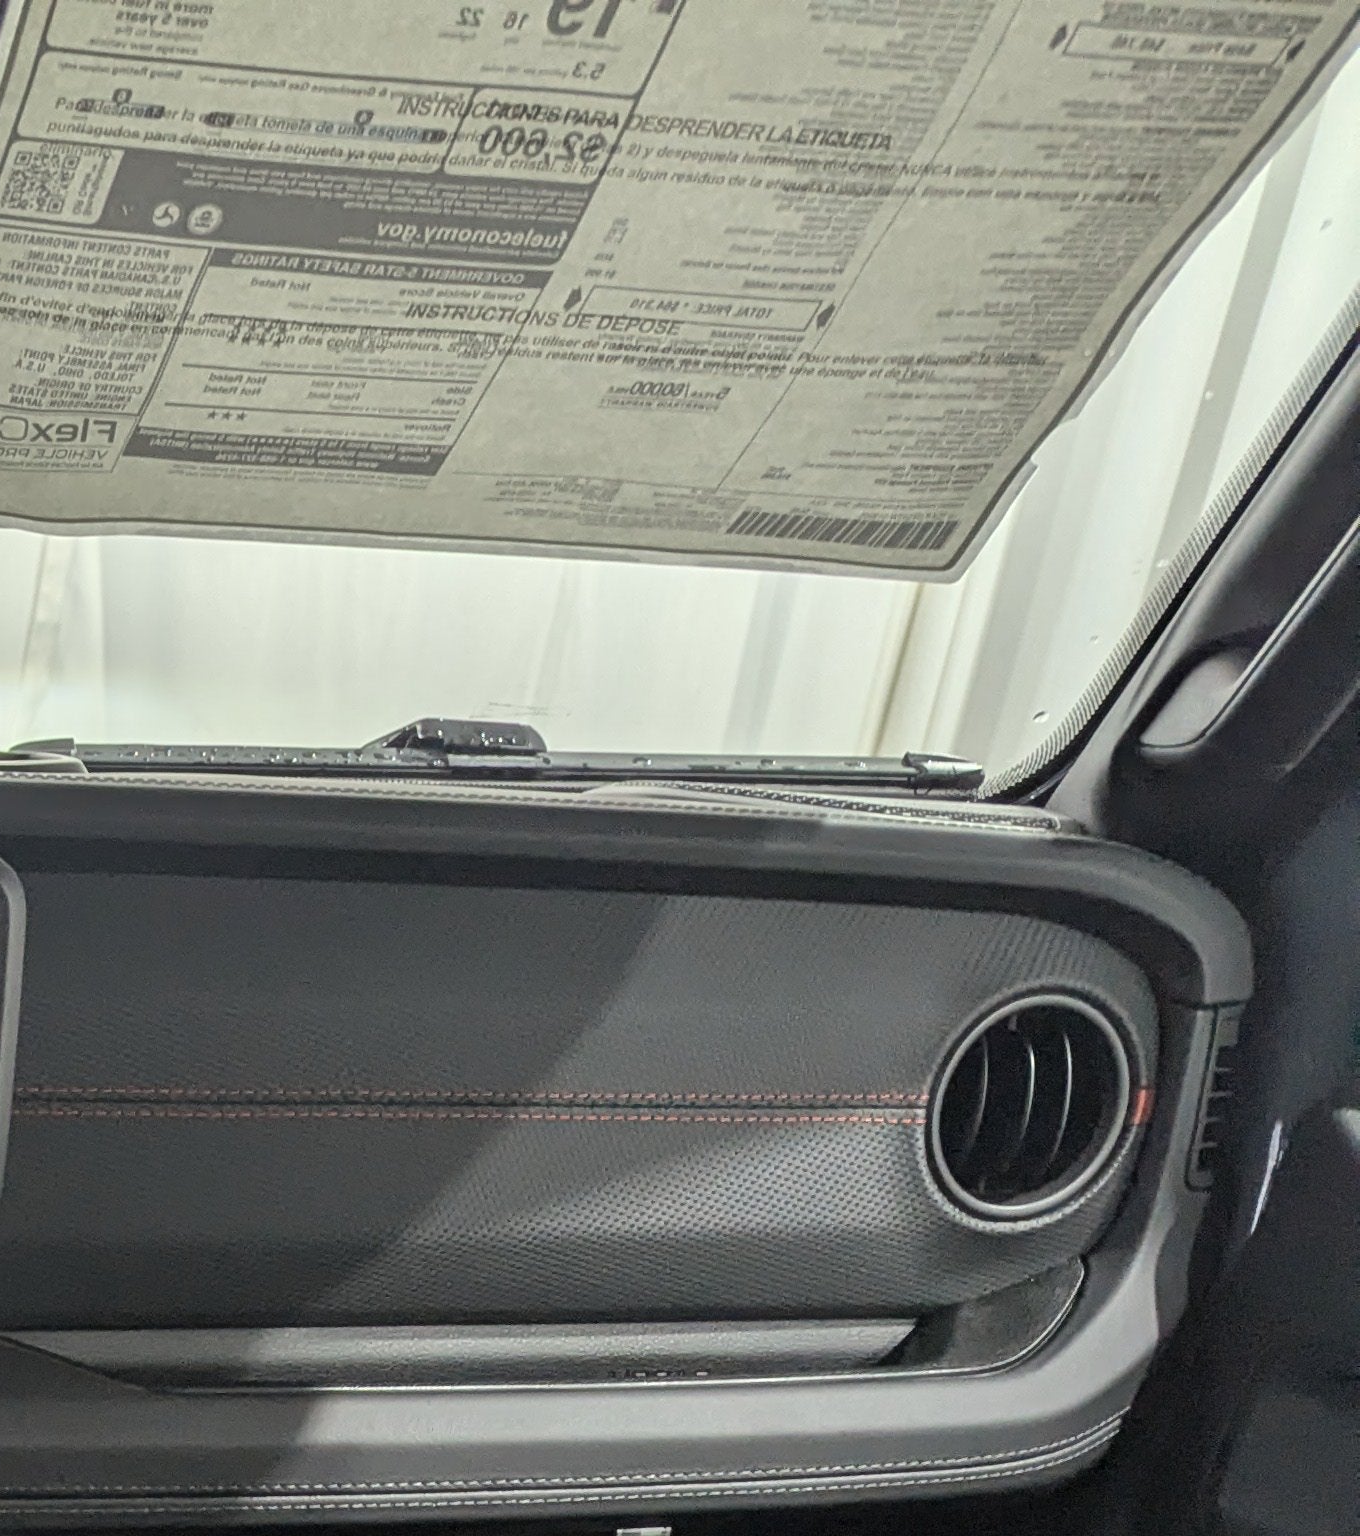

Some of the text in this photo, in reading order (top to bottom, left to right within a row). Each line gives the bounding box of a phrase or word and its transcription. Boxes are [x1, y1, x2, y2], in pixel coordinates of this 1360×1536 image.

[627, 114, 762, 139] DESPRENDER
[767, 125, 793, 141] LA
[796, 127, 892, 152] ETIQUETA
[407, 304, 561, 329] INSTRUCTIONS
[563, 314, 592, 328] DE
